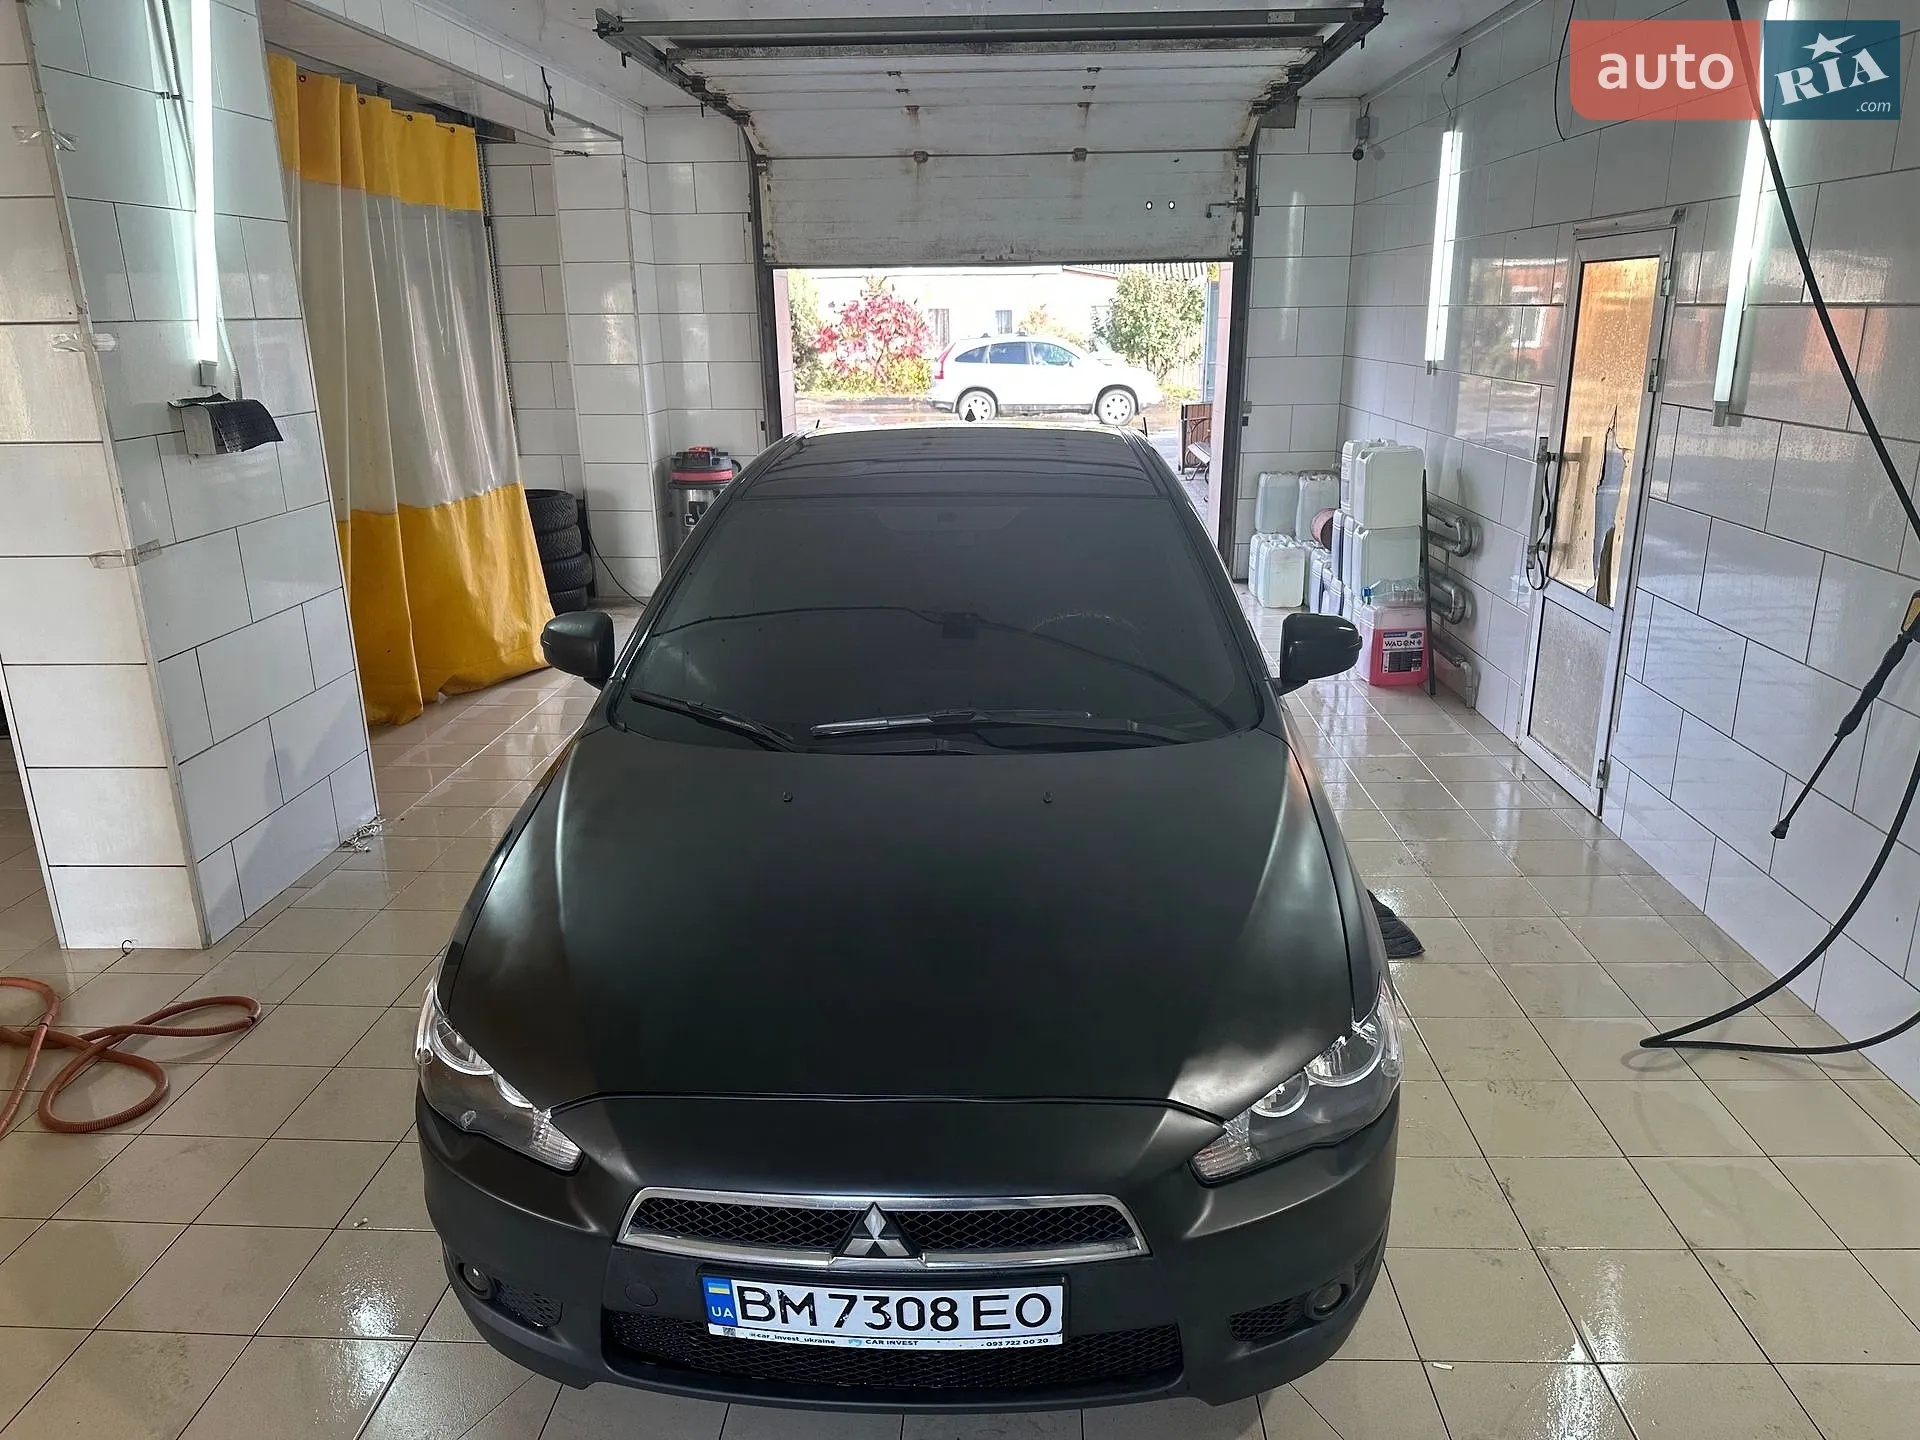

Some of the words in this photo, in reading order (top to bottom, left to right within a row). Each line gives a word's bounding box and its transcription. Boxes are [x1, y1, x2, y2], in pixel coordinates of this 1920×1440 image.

[711, 1305, 734, 1319] UA
[736, 1286, 816, 1327] BM
[827, 1293, 960, 1332] 7308
[973, 1292, 1052, 1331] EO
